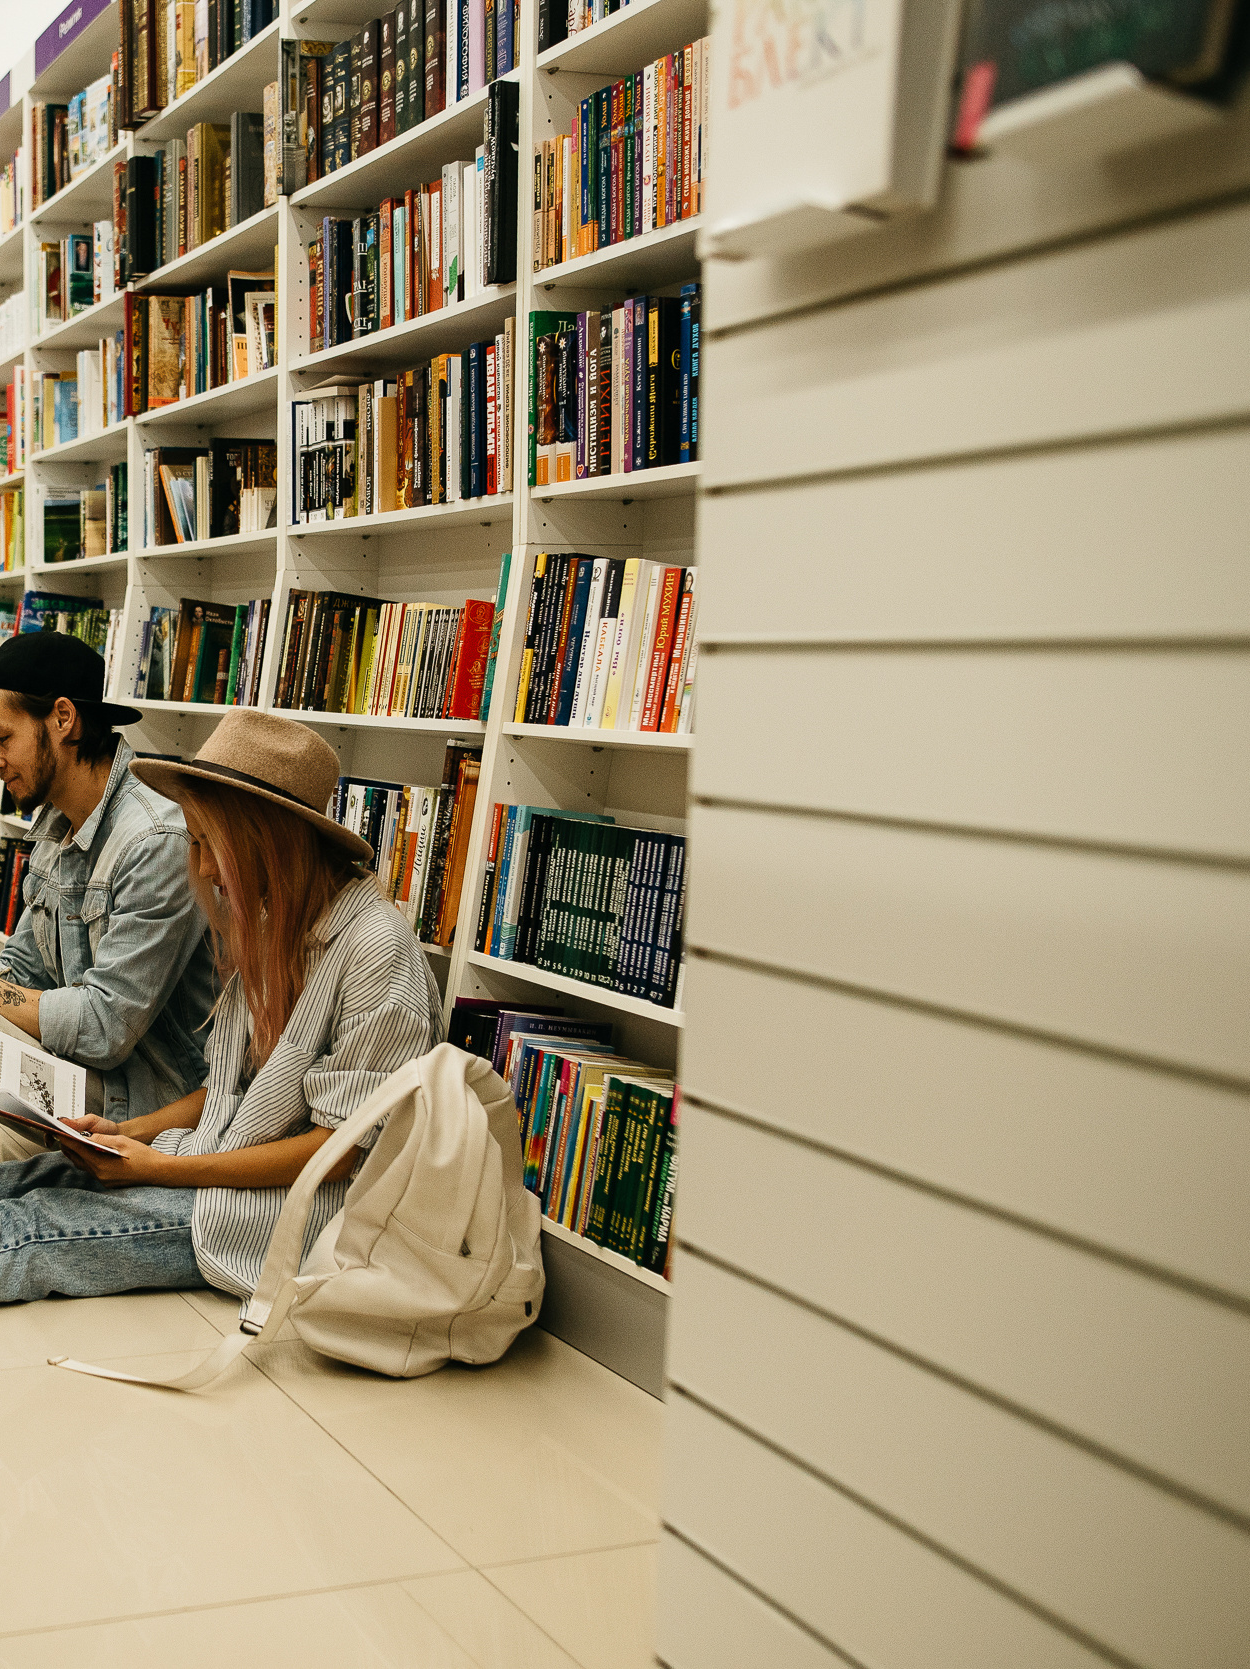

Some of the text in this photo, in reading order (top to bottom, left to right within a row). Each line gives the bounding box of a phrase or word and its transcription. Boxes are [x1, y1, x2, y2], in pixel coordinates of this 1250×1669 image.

[692, 323, 700, 348] ДУХОВ
[505, 359, 511, 368] 30
[486, 353, 495, 456] ИВАН ИЛЬИН
[589, 348, 598, 472] МИСТИЦИЗМ И ЙОГА
[600, 368, 611, 456] РЕРИХИ
[648, 404, 657, 460] Скрижали
[551, 563, 569, 655] Предназначение Души
[616, 612, 625, 645] боги»
[656, 572, 675, 649] Юрий МУХИН
[579, 631, 590, 668] Нектар
[595, 622, 608, 672] КАББАЛА
[572, 691, 580, 719] души
[642, 710, 651, 726] Мы
[478, 874, 490, 931] ВАДИМ ЗЕЛАНД
[659, 1150, 670, 1181] ЗАЧЕМ
[665, 1154, 680, 1194] ФАТУМ
[657, 1182, 665, 1199] МЫ
[657, 1204, 672, 1243] КАРМА
